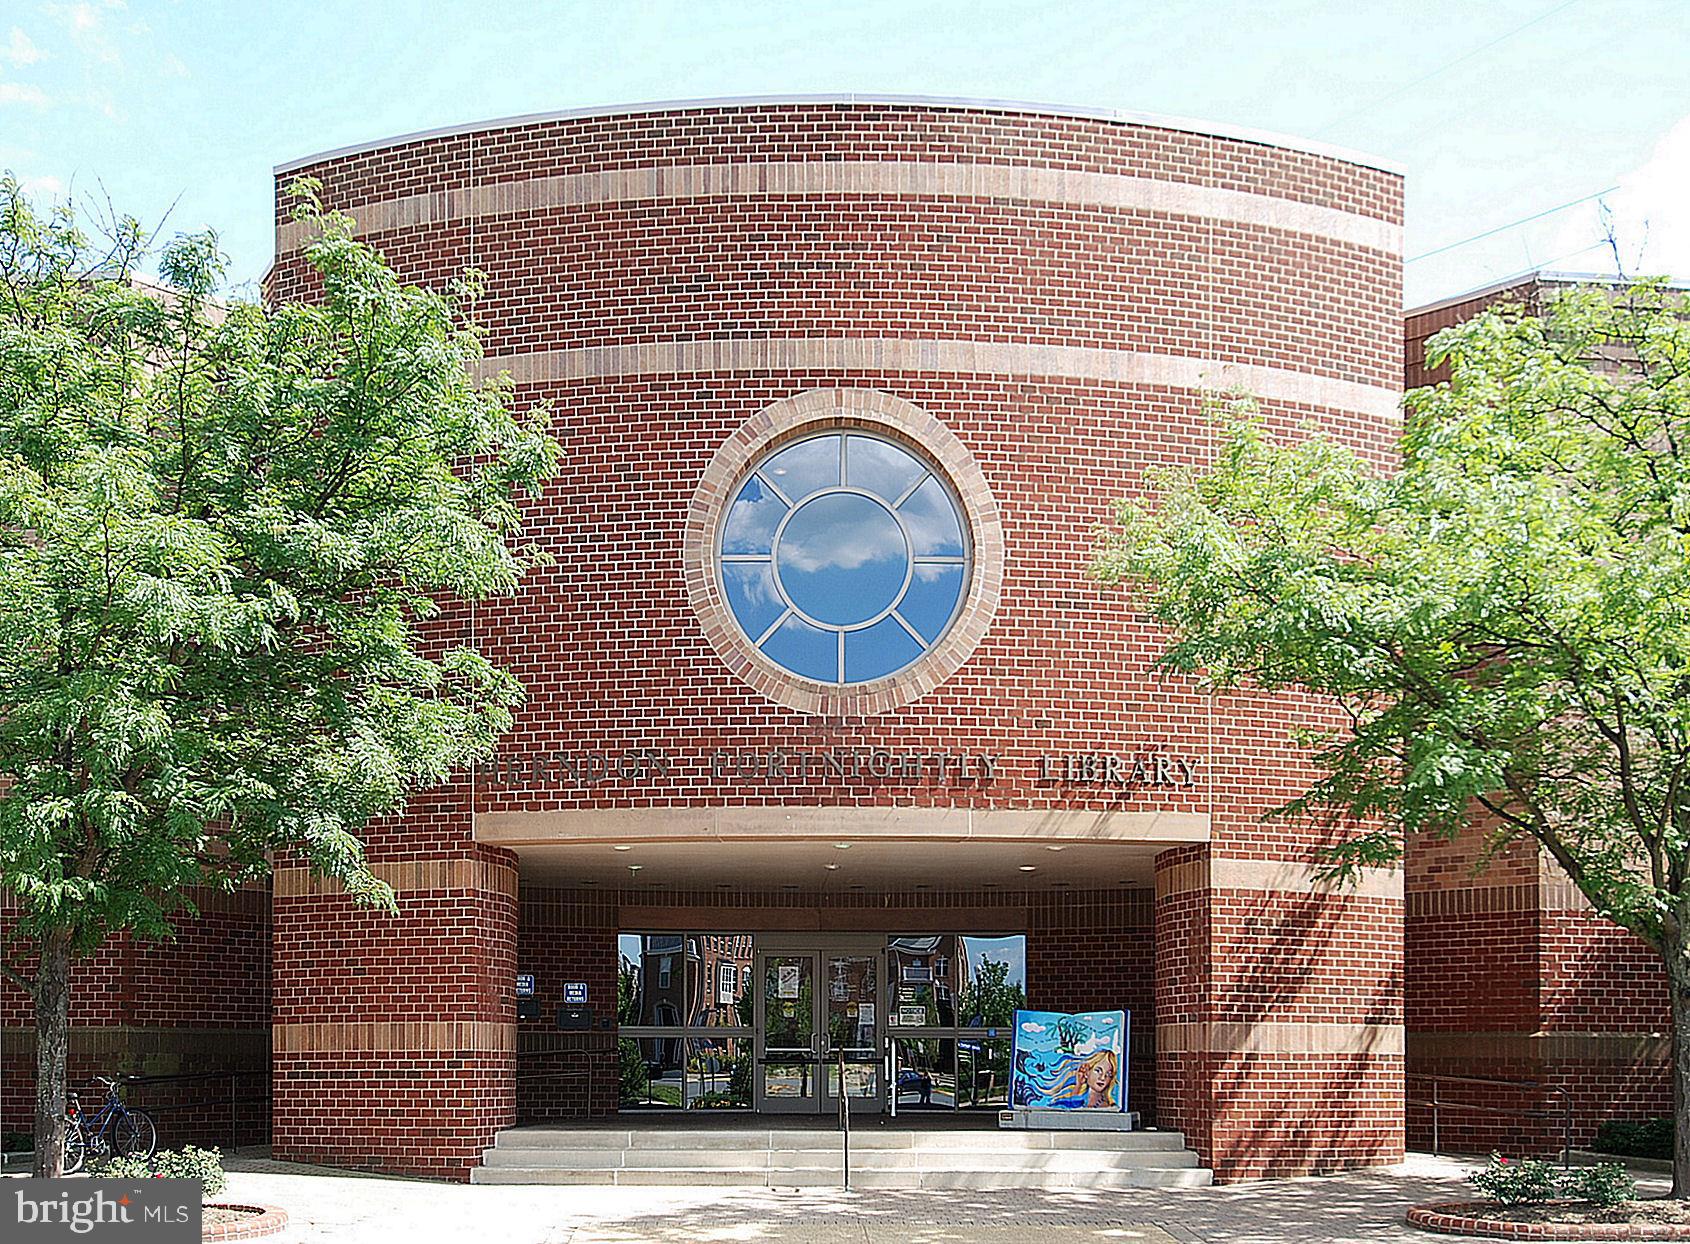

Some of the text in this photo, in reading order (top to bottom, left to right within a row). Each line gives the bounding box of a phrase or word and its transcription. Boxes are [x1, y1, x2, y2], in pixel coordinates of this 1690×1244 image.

[479, 751, 1200, 788] HERNDON FORTNIGHTLY LIBRARY
